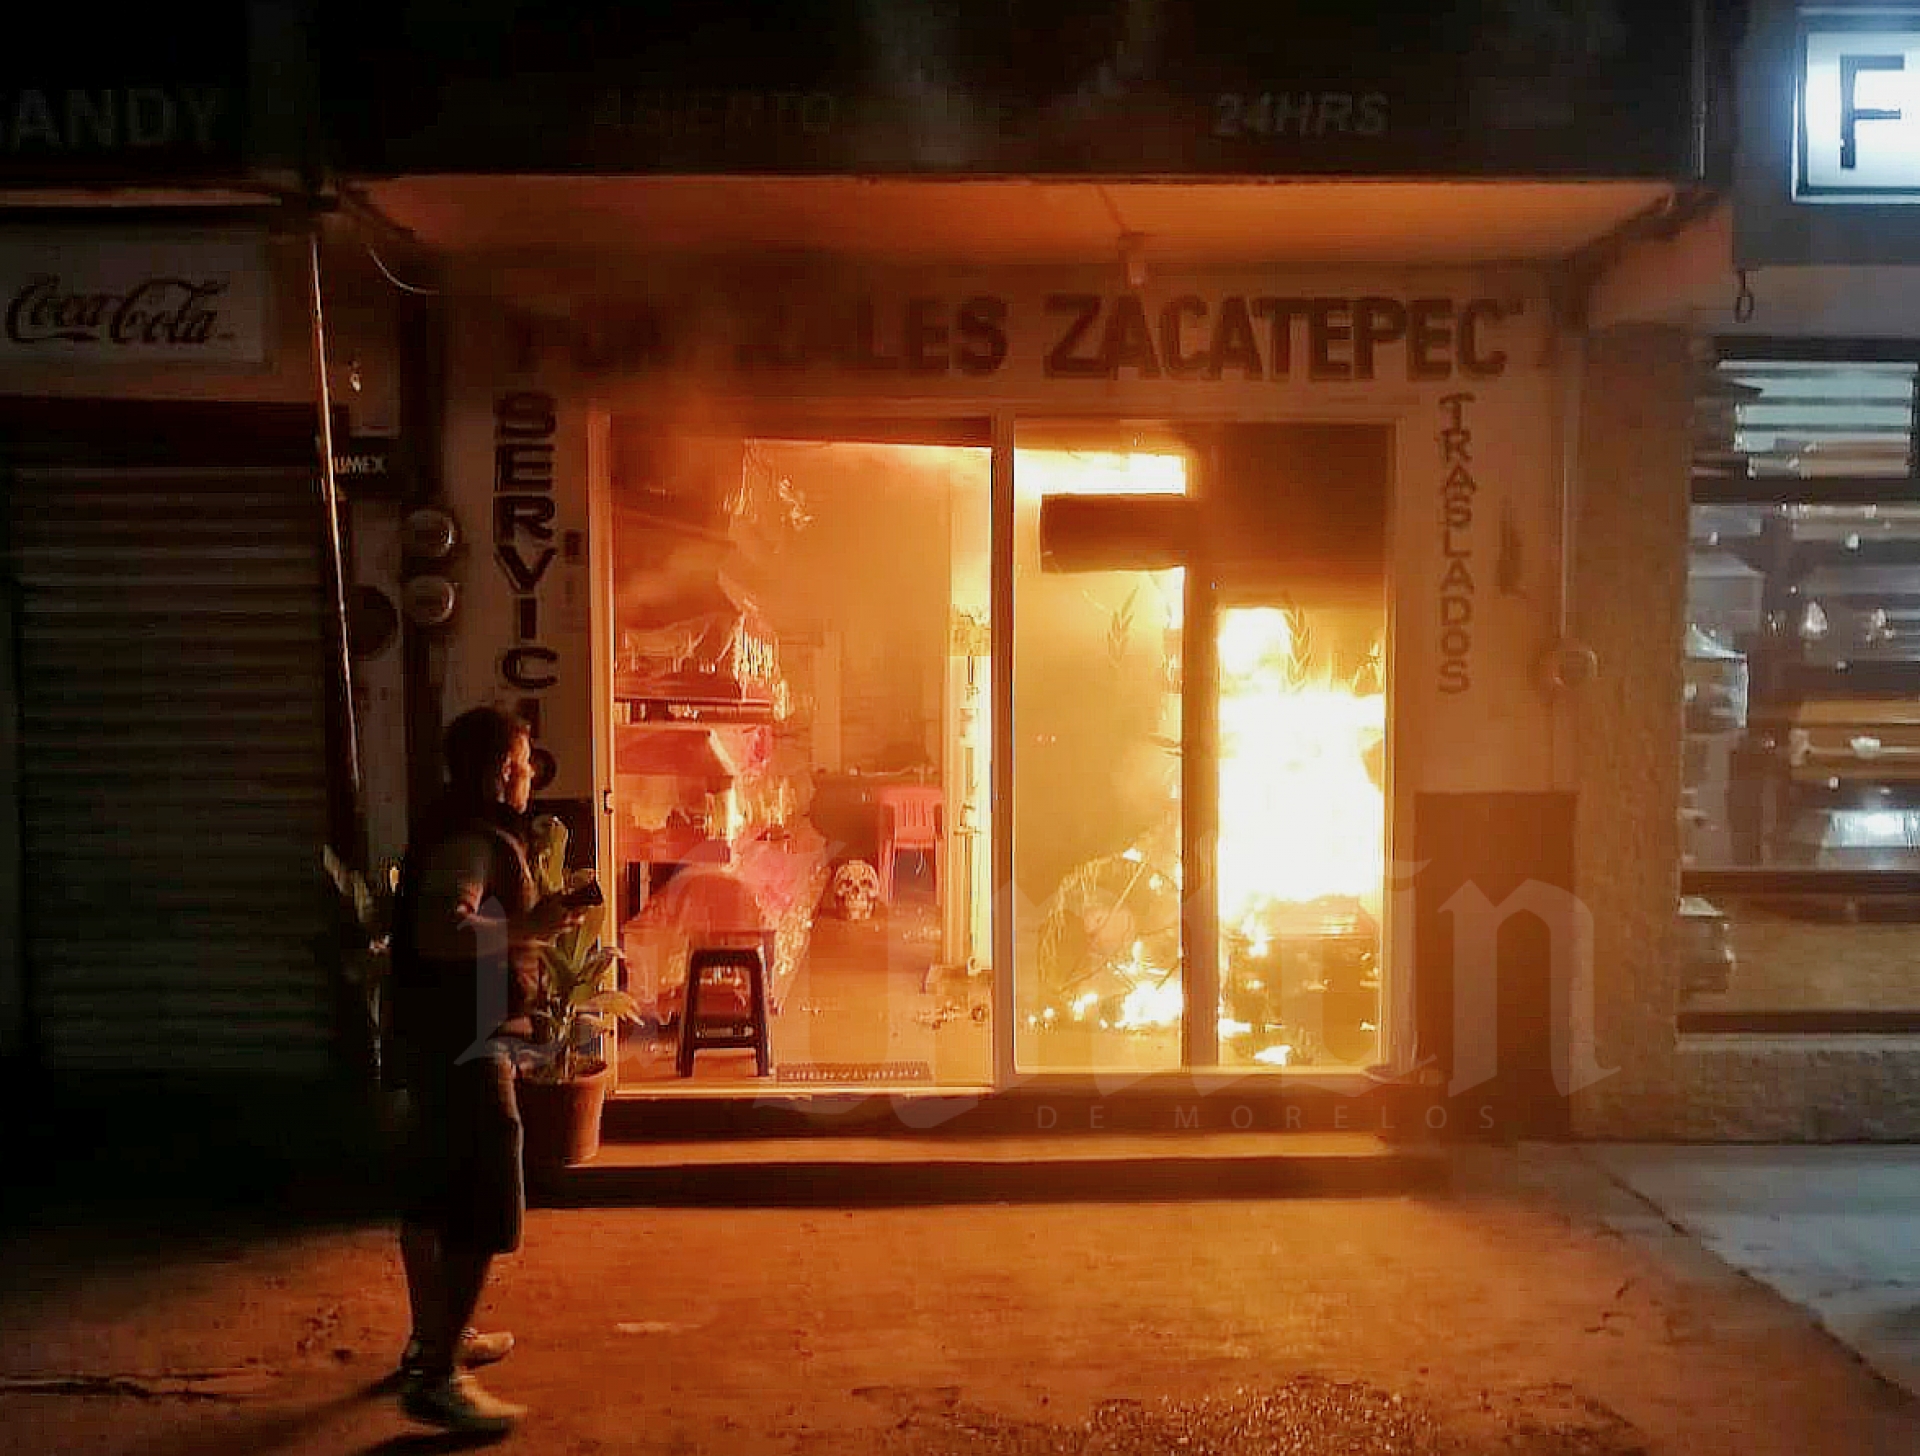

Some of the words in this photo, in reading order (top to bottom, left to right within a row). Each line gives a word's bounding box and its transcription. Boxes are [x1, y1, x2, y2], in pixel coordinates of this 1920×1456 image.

[0, 88, 228, 152] ANDY
[1212, 92, 1390, 137] 24HRS
[1437, 392, 1476, 694] TRASLADOS
